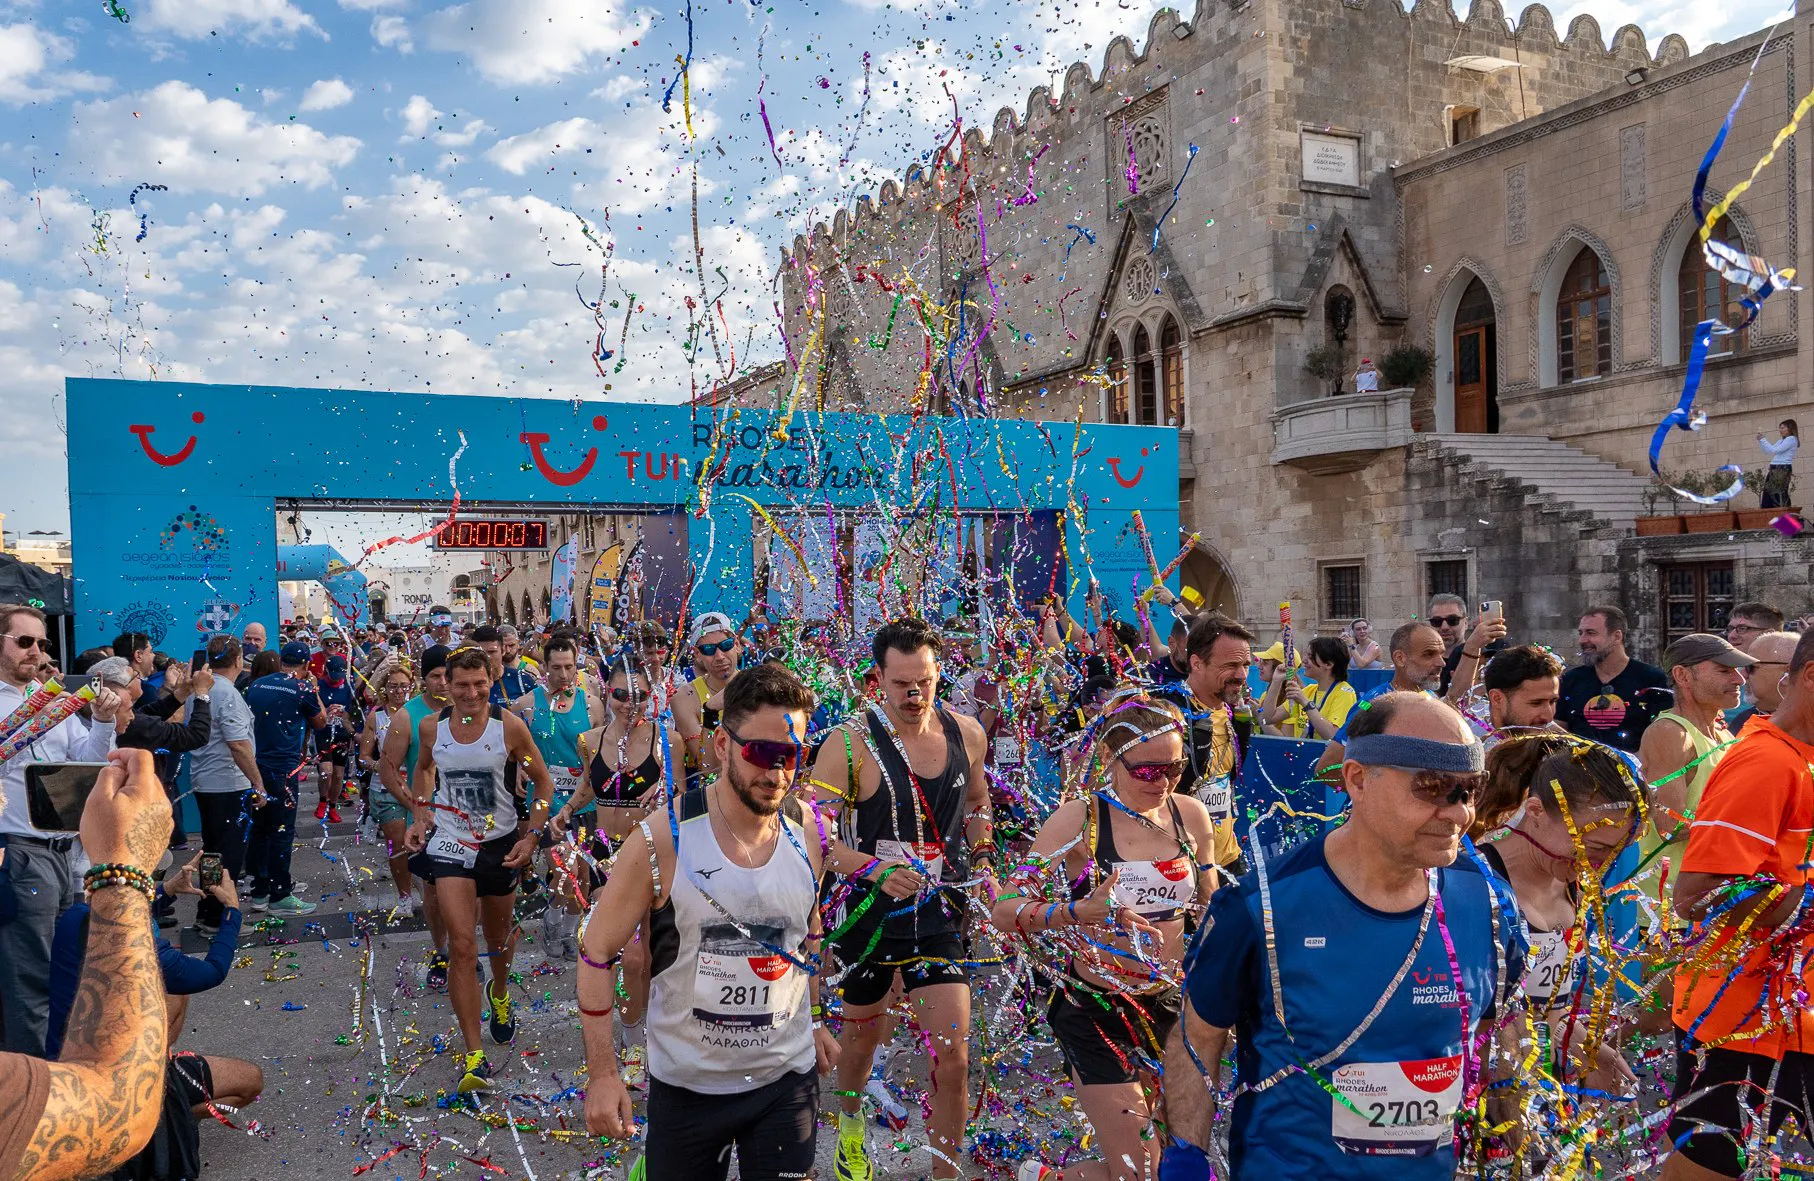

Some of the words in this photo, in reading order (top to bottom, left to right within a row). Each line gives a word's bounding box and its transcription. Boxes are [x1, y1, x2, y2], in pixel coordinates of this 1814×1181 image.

[619, 451, 679, 480] TUI
[404, 594, 433, 604] RONDA
[556, 777, 577, 786] 2794
[1204, 792, 1227, 807] 4007
[437, 840, 465, 855] 2806
[1135, 885, 1177, 905] 2094
[756, 962, 789, 973] MARATHON
[767, 958, 782, 967] HALF
[698, 969, 737, 979] marathon
[719, 985, 770, 1005] 2811
[1412, 985, 1450, 994] RHODES
[1412, 989, 1473, 1004] marathn
[1427, 1062, 1448, 1073] HALF
[1413, 1068, 1458, 1082] MARATHON
[1336, 1083, 1388, 1093] marathon
[1368, 1099, 1440, 1127] 2703
